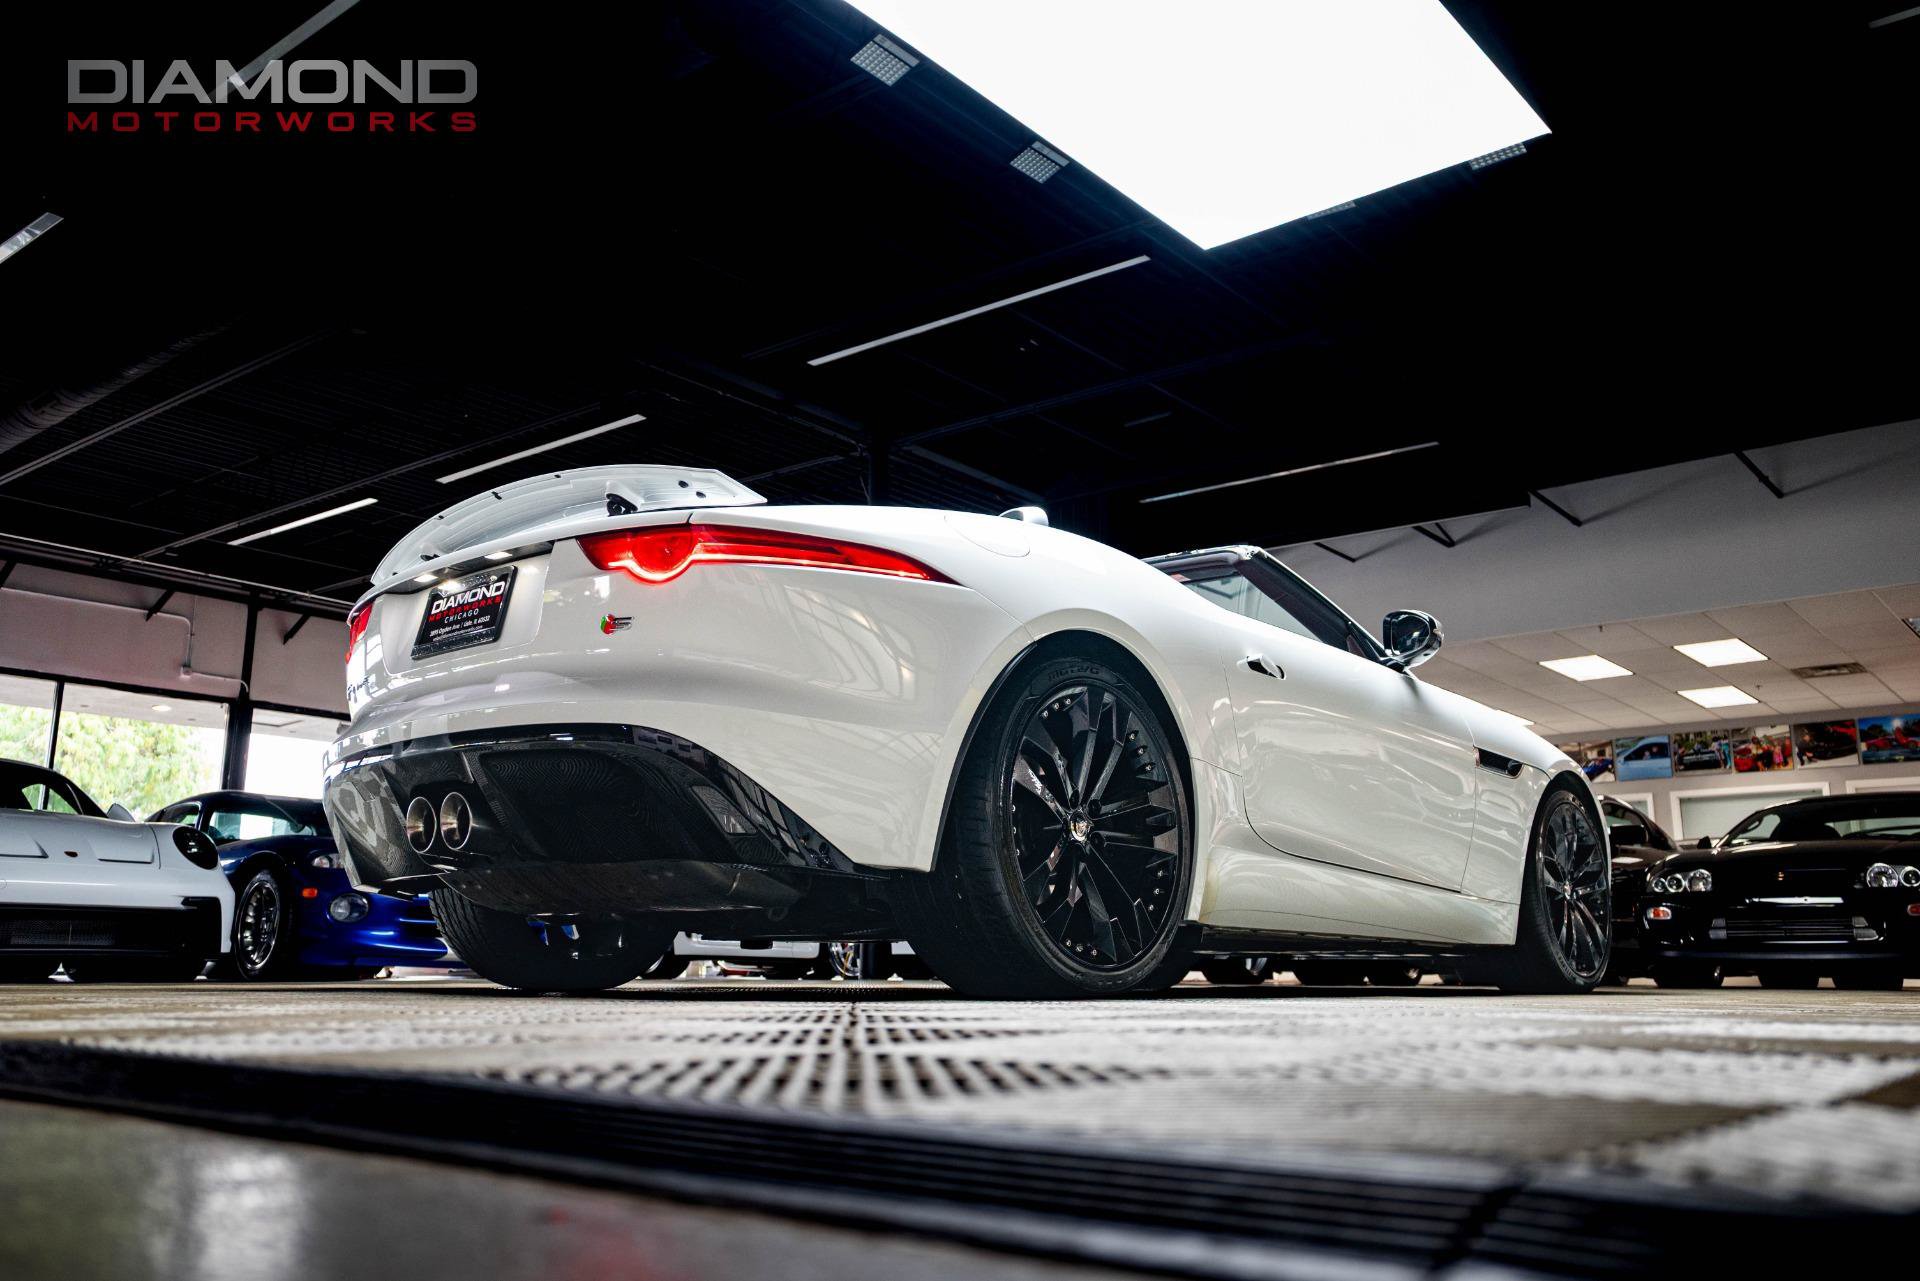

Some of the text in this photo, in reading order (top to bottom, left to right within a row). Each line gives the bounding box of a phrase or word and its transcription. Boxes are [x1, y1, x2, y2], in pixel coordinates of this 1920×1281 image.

[427, 595, 503, 622] MOTORWORKS
[431, 581, 506, 614] DIAMOND
[444, 608, 480, 624] CHICAGO
